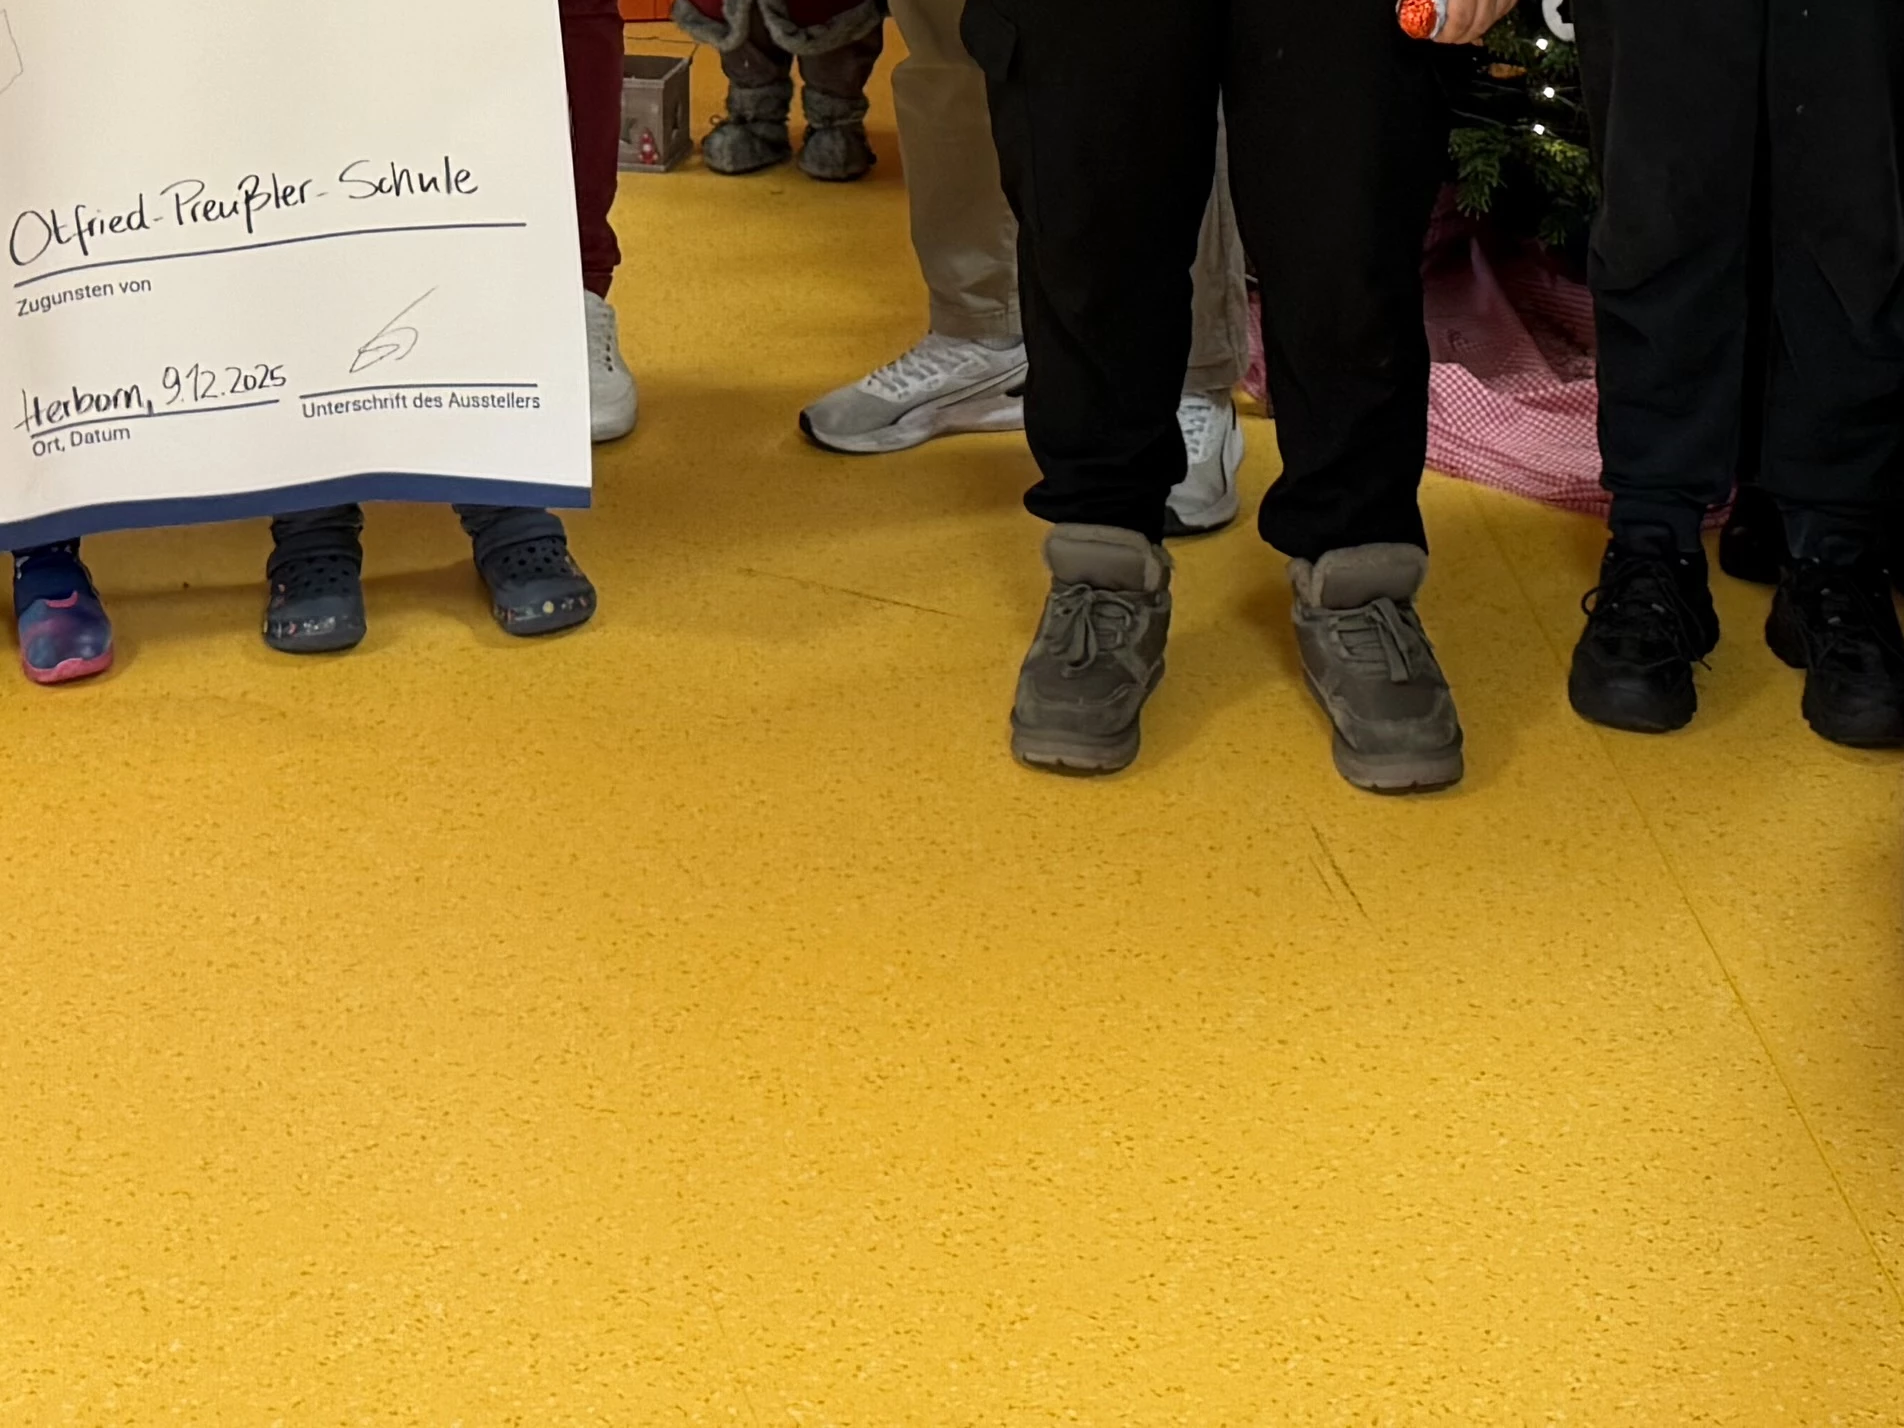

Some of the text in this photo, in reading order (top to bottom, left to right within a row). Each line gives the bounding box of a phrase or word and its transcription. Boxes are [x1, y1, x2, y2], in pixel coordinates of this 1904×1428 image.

[16, 279, 152, 318] Zugunsten von
[302, 390, 541, 420] Unterschrift des Ausstellers
[32, 425, 131, 458] Ort, Datum
